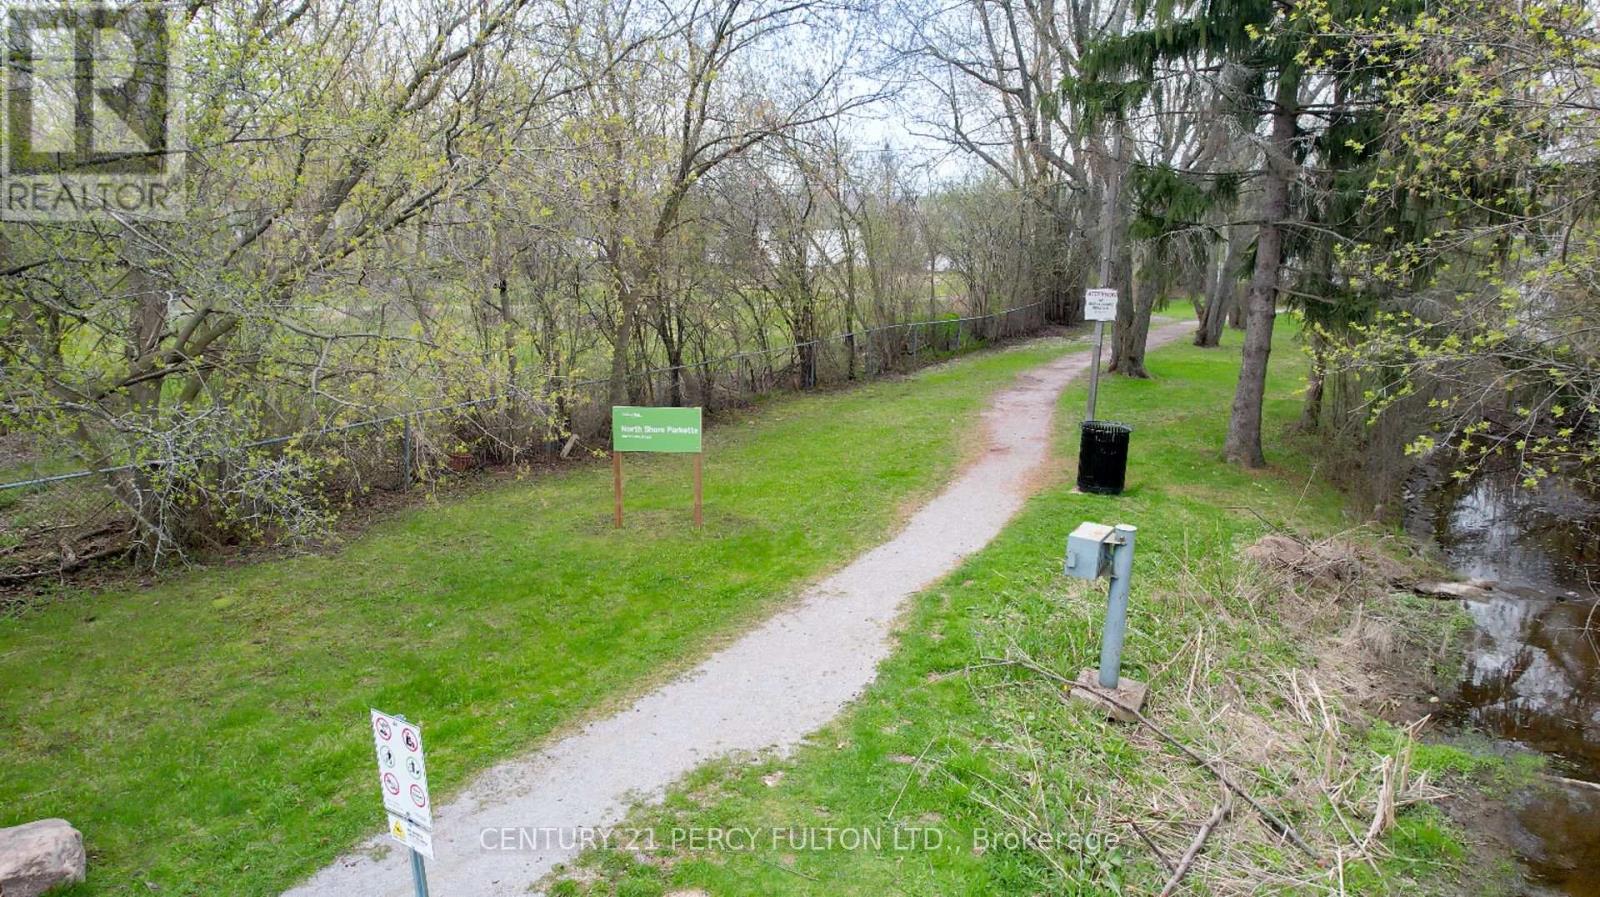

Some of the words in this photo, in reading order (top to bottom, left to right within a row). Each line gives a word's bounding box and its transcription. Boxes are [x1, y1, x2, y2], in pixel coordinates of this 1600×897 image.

[621, 425, 643, 433] North
[644, 425, 665, 434] Shore
[667, 426, 699, 435] Parkette
